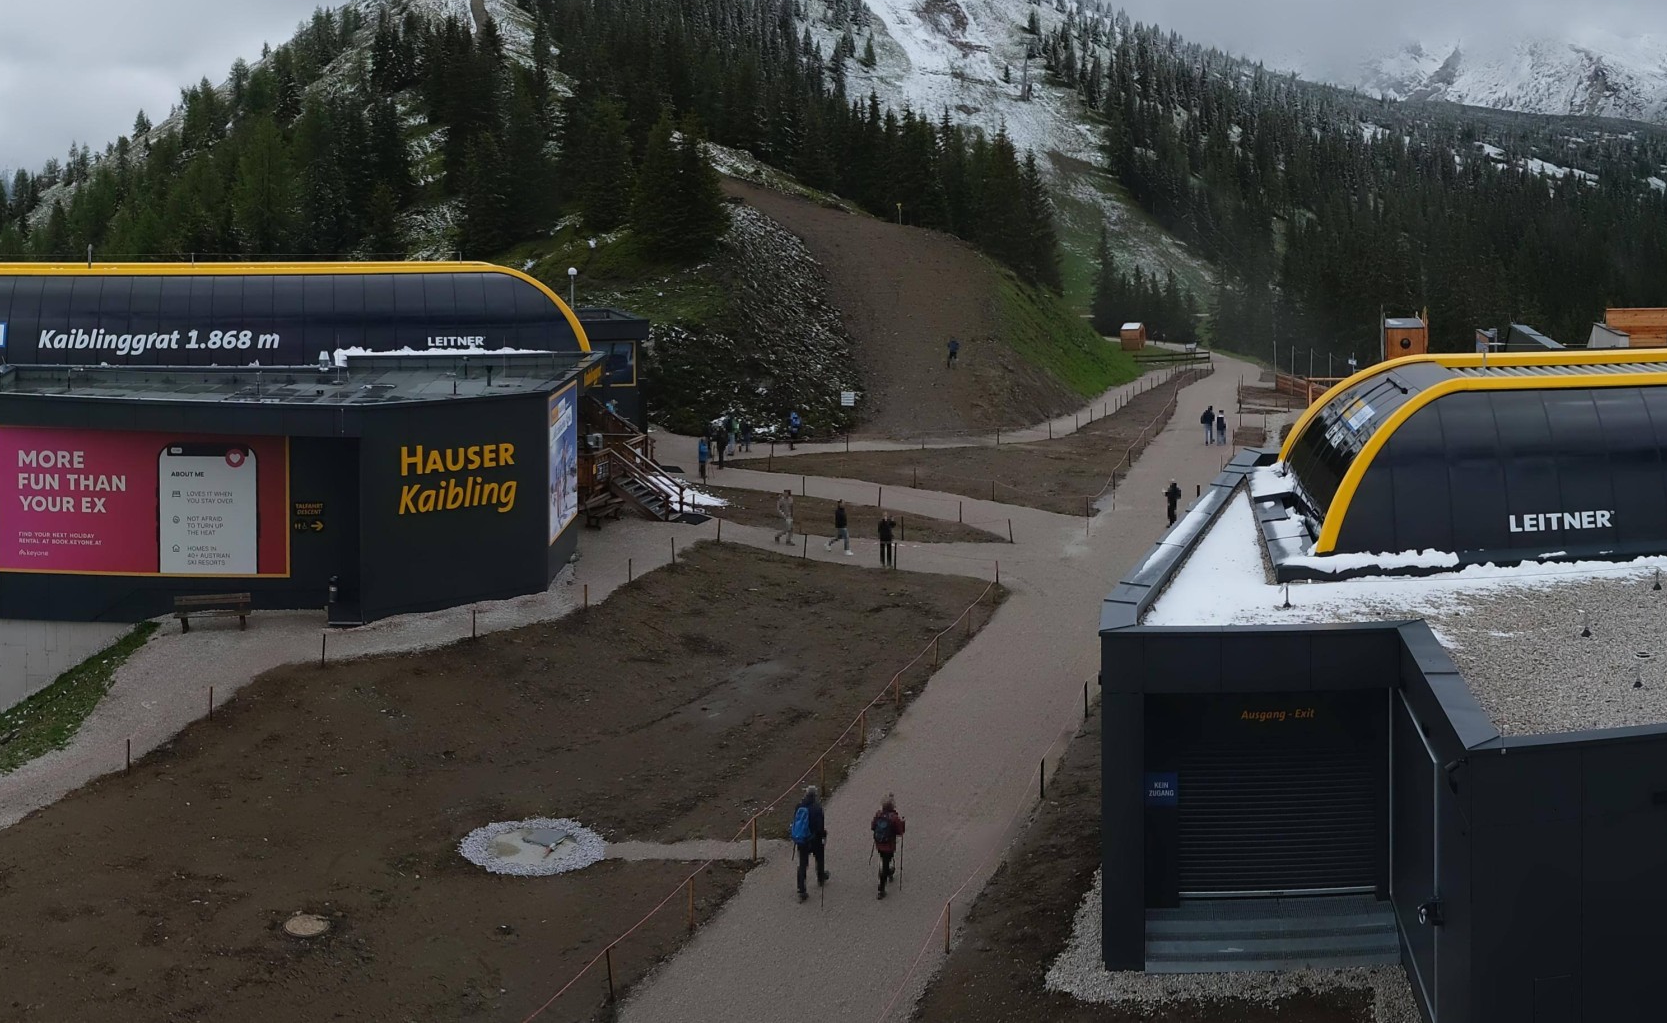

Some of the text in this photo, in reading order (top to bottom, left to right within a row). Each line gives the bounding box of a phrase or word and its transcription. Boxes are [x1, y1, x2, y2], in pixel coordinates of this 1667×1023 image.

[38, 329, 280, 355] Kaiblinggrat 1.868 m
[427, 336, 485, 346] LEITNER
[18, 450, 85, 468] MORE
[401, 443, 515, 476] HAUSER
[18, 473, 126, 491] FUN THAN
[19, 496, 107, 513] YOUR EX
[398, 477, 517, 515] Kaibling
[1509, 510, 1613, 532] LEITNER
[1240, 710, 1286, 722] Ausgang
[1294, 708, 1315, 719] Exit
[1148, 789, 1174, 797] ZUGANG
